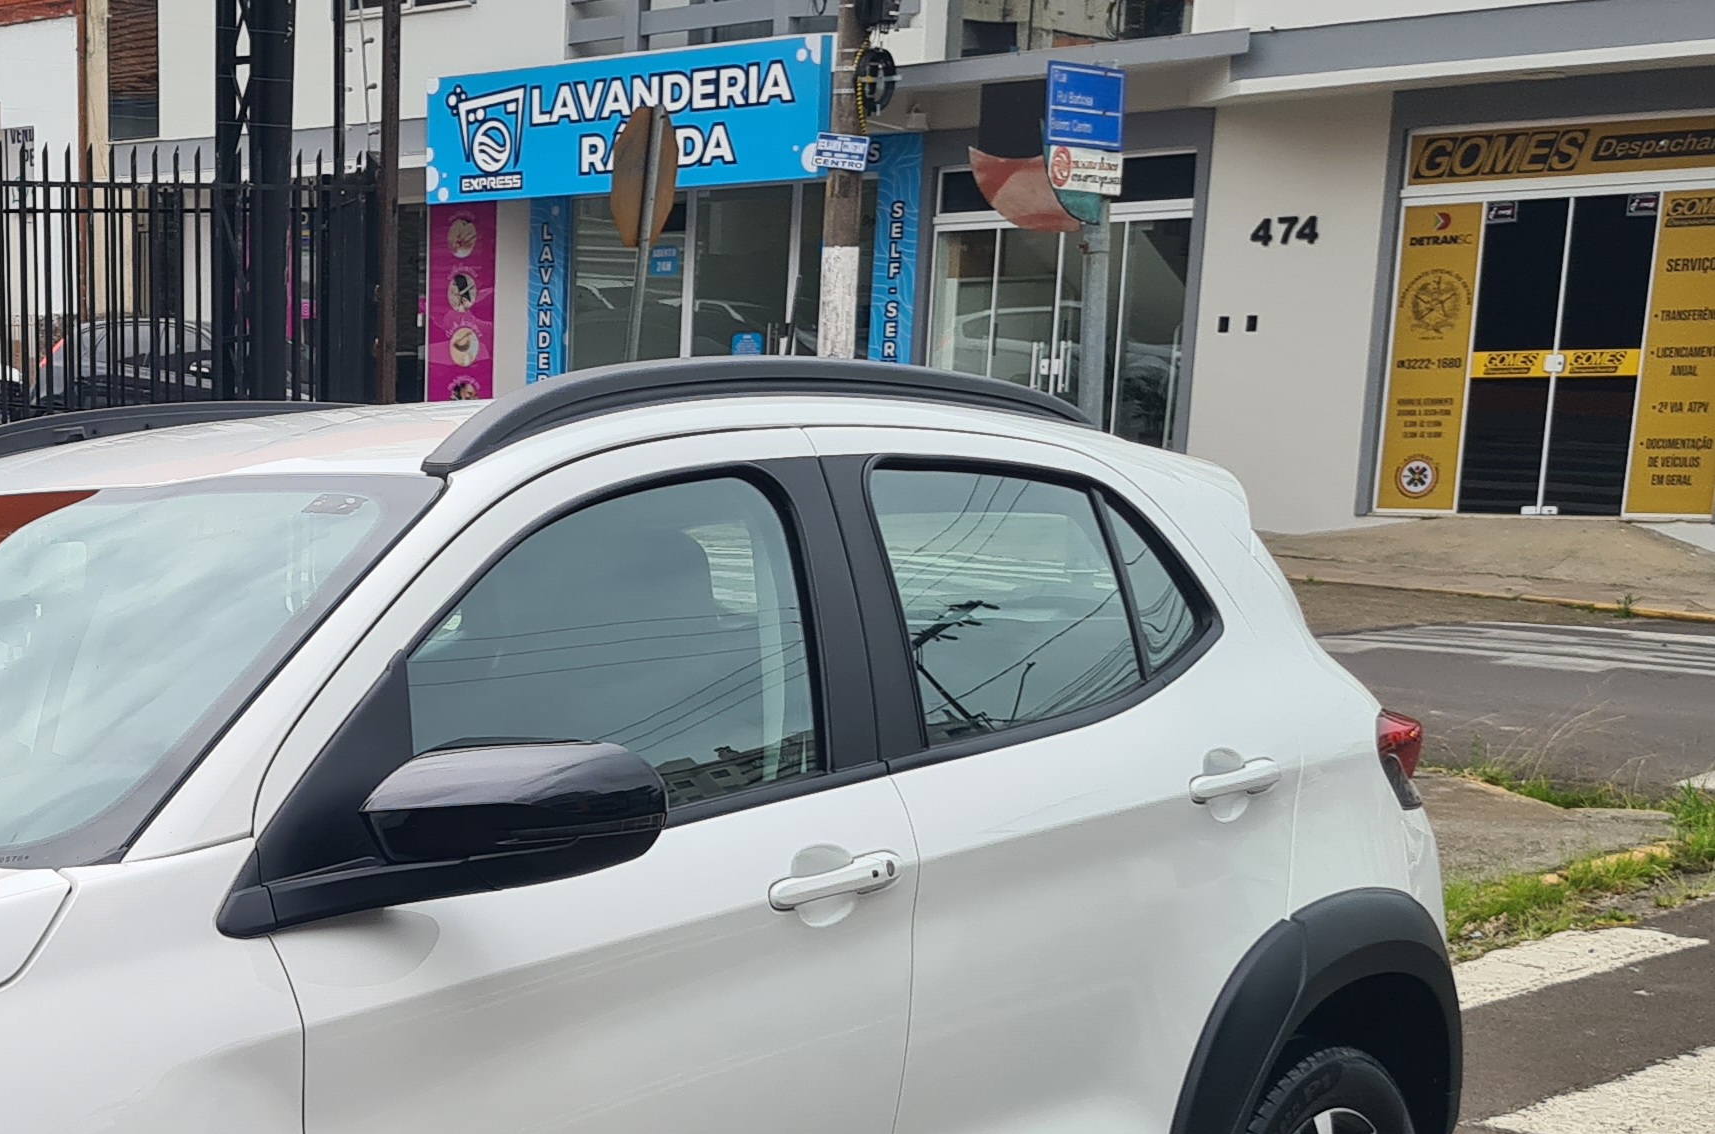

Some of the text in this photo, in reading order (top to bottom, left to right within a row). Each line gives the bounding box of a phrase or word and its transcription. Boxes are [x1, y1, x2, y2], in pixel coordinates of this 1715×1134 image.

[531, 61, 794, 125] LAVANDERIA
[580, 122, 736, 174] RDA
[1414, 129, 1589, 179] GOMES
[814, 157, 863, 169] CENTRO
[461, 174, 522, 191] EXPRESS
[1250, 215, 1319, 247] 474
[883, 202, 904, 360] SELF-SER
[1485, 353, 1539, 367] GOMES
[1570, 351, 1627, 366] GOMES
[1670, 402, 1683, 413] VIA
[1647, 454, 1701, 468] DE VEÍCULOS
[1651, 474, 1693, 486] EM GERAL
